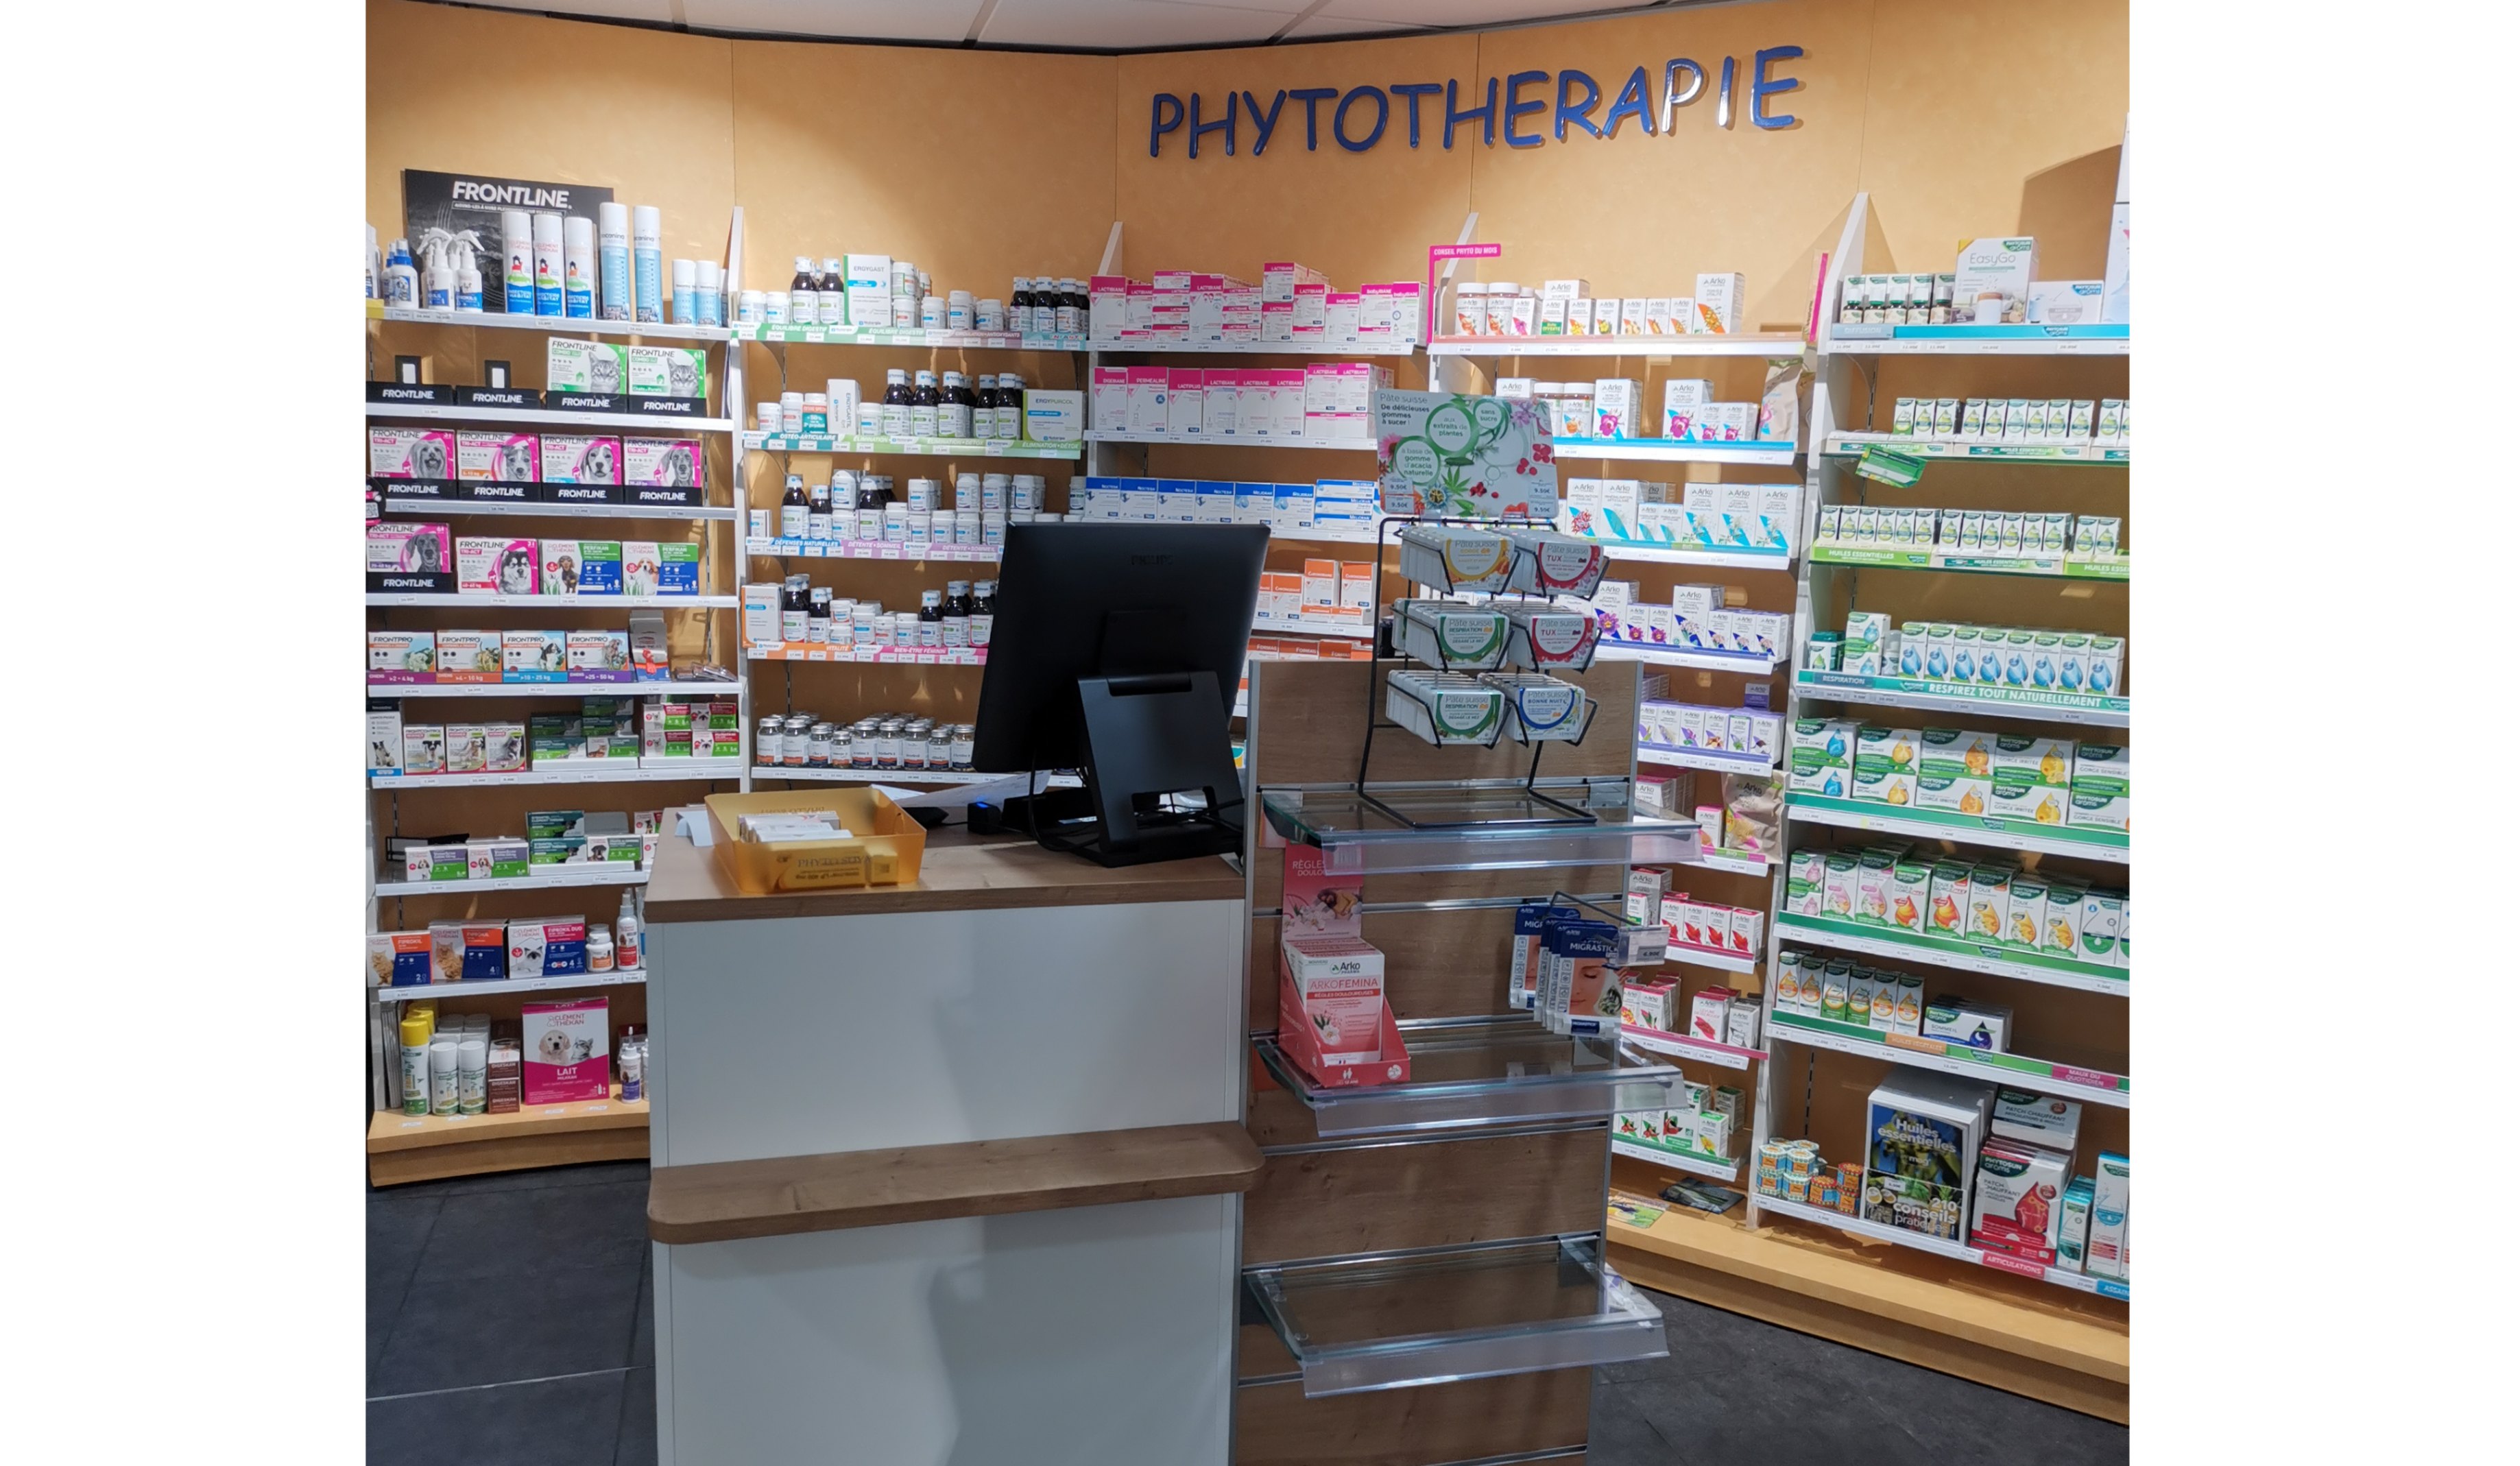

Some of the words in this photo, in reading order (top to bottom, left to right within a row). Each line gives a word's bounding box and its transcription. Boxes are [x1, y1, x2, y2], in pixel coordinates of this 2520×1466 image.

[1150, 46, 1803, 158] PHYTOTHERAPIE
[453, 181, 568, 208] FRONTLINE
[1970, 252, 2015, 265] EasyGo
[1710, 278, 1725, 286] Arko
[552, 341, 597, 352] FRONTLINE
[632, 349, 674, 357] FRONTLINE
[383, 389, 433, 399] FRONTLINE
[473, 394, 522, 402] FRONTLINE
[1380, 394, 1400, 402] Pâte
[562, 398, 610, 407] FRONTLINE
[644, 402, 690, 411] FRONTLINE
[373, 429, 420, 438] FRONTLINE
[460, 433, 505, 441] FRONTLINE
[545, 437, 589, 445] FRONTLINE
[388, 485, 439, 494] FRONTLINE
[475, 488, 525, 496] FRONTLINE
[558, 490, 606, 498] FRONTLINE
[640, 492, 686, 501] FRONTLINE
[1455, 540, 1472, 548] Pâte
[1546, 544, 1564, 553] Pâte
[1829, 550, 1850, 559] HUILES
[1852, 551, 1894, 560] ESSENTIELLES
[383, 579, 434, 587] FRONTLINE
[1686, 591, 1702, 599] Arko
[1449, 618, 1465, 627] Pâte
[826, 643, 849, 652] VITALITÉ
[1823, 675, 1865, 685] RESPIRATION
[1528, 690, 1545, 699] Pâte
[1547, 690, 1570, 699] suisse
[1929, 684, 1975, 697] RESPIREZ
[1978, 688, 2006, 699] TOUT
[2009, 690, 2101, 708] NATURELLEMENT
[1445, 695, 1463, 704] Pâte
[1310, 978, 1378, 989] ARKOFEMINA
[557, 1067, 577, 1076] LAIT
[2069, 1069, 2087, 1077] MAUX
[2065, 1074, 2104, 1086] QUOTIDIEN
[2006, 1106, 2028, 1115] PATCH
[2031, 1110, 2066, 1122] CHAUFFANT
[1896, 1118, 1939, 1138] Huiles
[1877, 1127, 1956, 1152] essentielles
[1984, 1162, 2011, 1173] aroms
[1985, 1157, 2022, 1170] PHYTOSUN
[1932, 1197, 1957, 1211] 210
[1893, 1201, 1956, 1224] conseils
[1986, 1255, 2041, 1275] ARTICULATIONS
